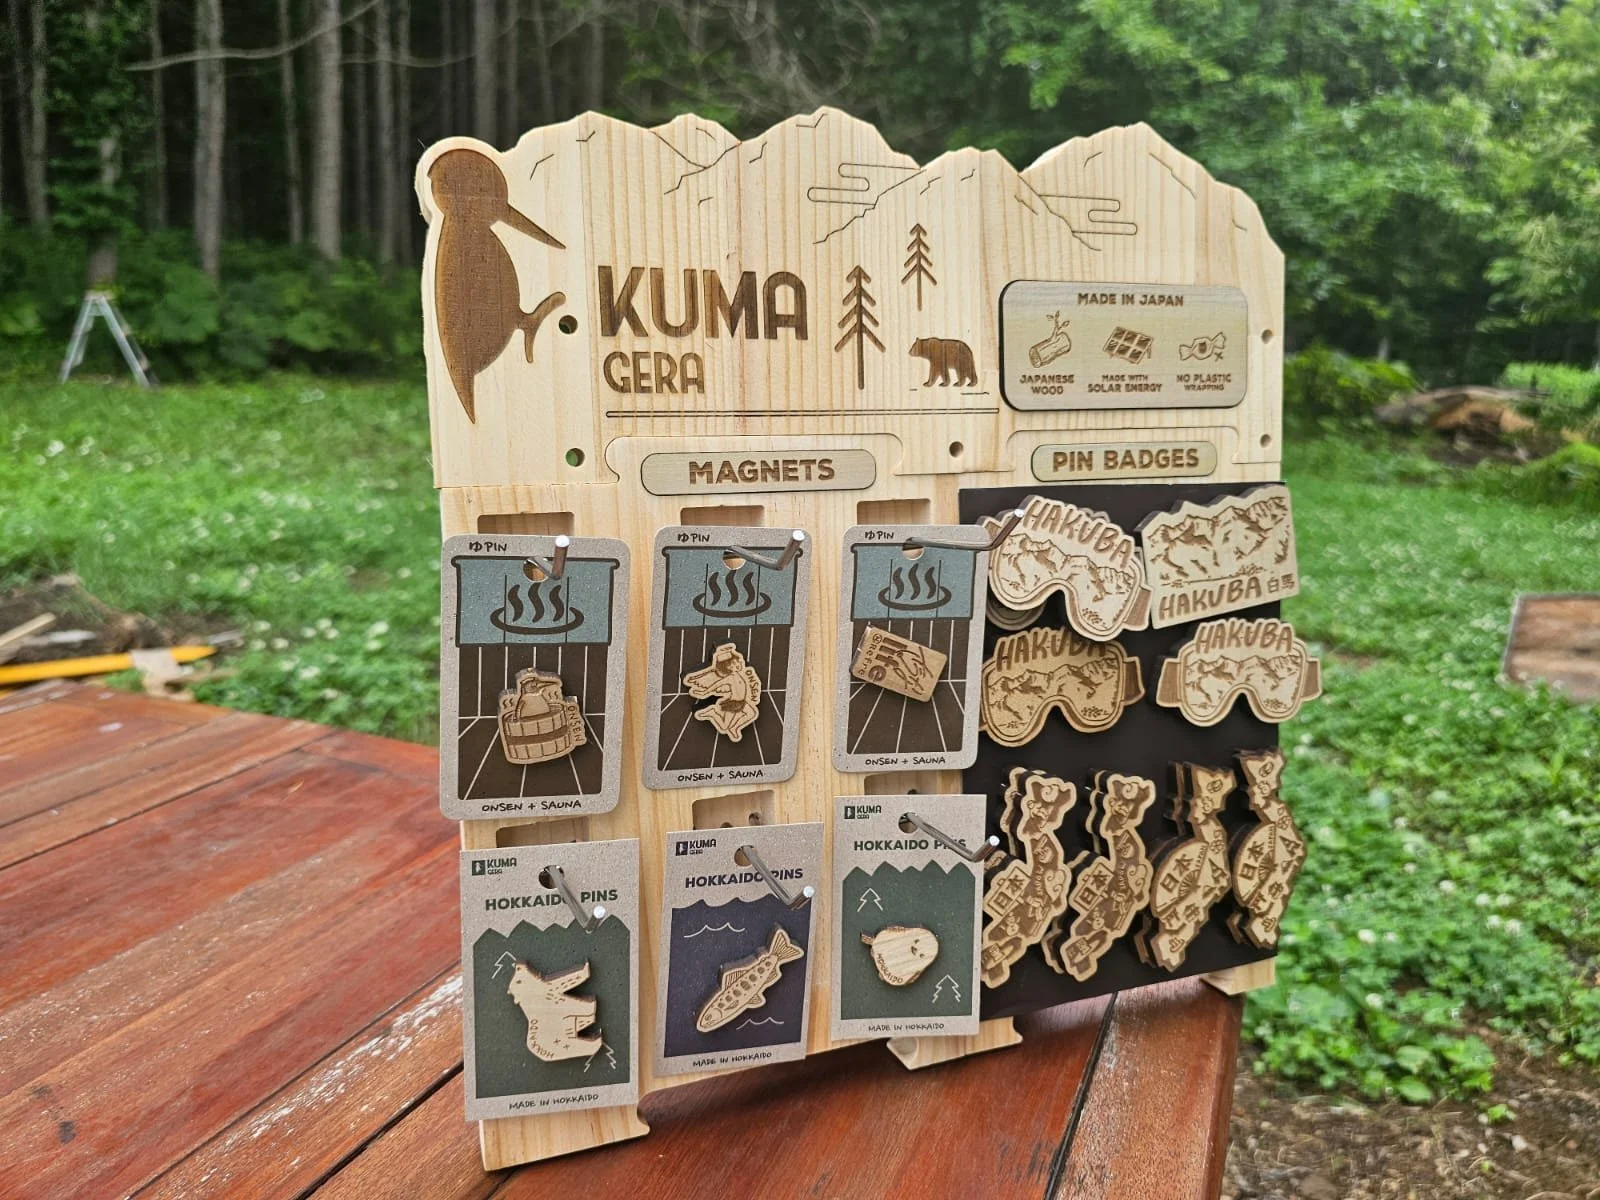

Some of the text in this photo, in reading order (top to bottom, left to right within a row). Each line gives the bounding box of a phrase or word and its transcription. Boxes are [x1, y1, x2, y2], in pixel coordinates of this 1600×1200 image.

[598, 265, 808, 341] KUMA
[1078, 293, 1184, 306] MADE IN JAPAN
[603, 351, 705, 394] GERA
[1020, 374, 1075, 384] JAPANESE
[1102, 374, 1149, 382] MADE WITH
[1176, 374, 1232, 383] NO PLASTIC
[1031, 385, 1064, 395] WOOD
[1088, 383, 1162, 393] SOLAR ENERGY
[1184, 384, 1225, 392] WRAPPING
[1053, 448, 1200, 473] PIN BADGES
[689, 458, 835, 485] MAGNETS
[1022, 499, 1132, 568] HAKUBA
[1158, 572, 1295, 620] HAKUBA 白馬
[1196, 620, 1293, 654] HAKUBA
[745, 670, 759, 702] ONSEN
[568, 705, 585, 742] ONSEN
[865, 757, 898, 766] ONSEN
[912, 756, 946, 765] SAUNA
[677, 773, 713, 781] ONSEN
[728, 770, 764, 779] SAUNA
[482, 803, 523, 812] ONSEN
[541, 800, 582, 810] SAUNA
[856, 805, 882, 814] KUMA
[689, 838, 717, 849] KUMA
[854, 840, 929, 851] HOKKAIDO
[487, 857, 517, 868] KUMA
[1239, 840, 1265, 881] 日本
[1160, 853, 1194, 893] 日本
[581, 889, 618, 903] PINS
[993, 873, 1024, 912] 日本
[1077, 870, 1111, 908] 日本
[877, 953, 904, 984] HOKKAIDO
[868, 1023, 891, 1032] MADE
[693, 1058, 716, 1067] MADE
[731, 1052, 772, 1062] HOKKAIDO
[508, 1093, 599, 1110] MADE IN HOKKAIDO
